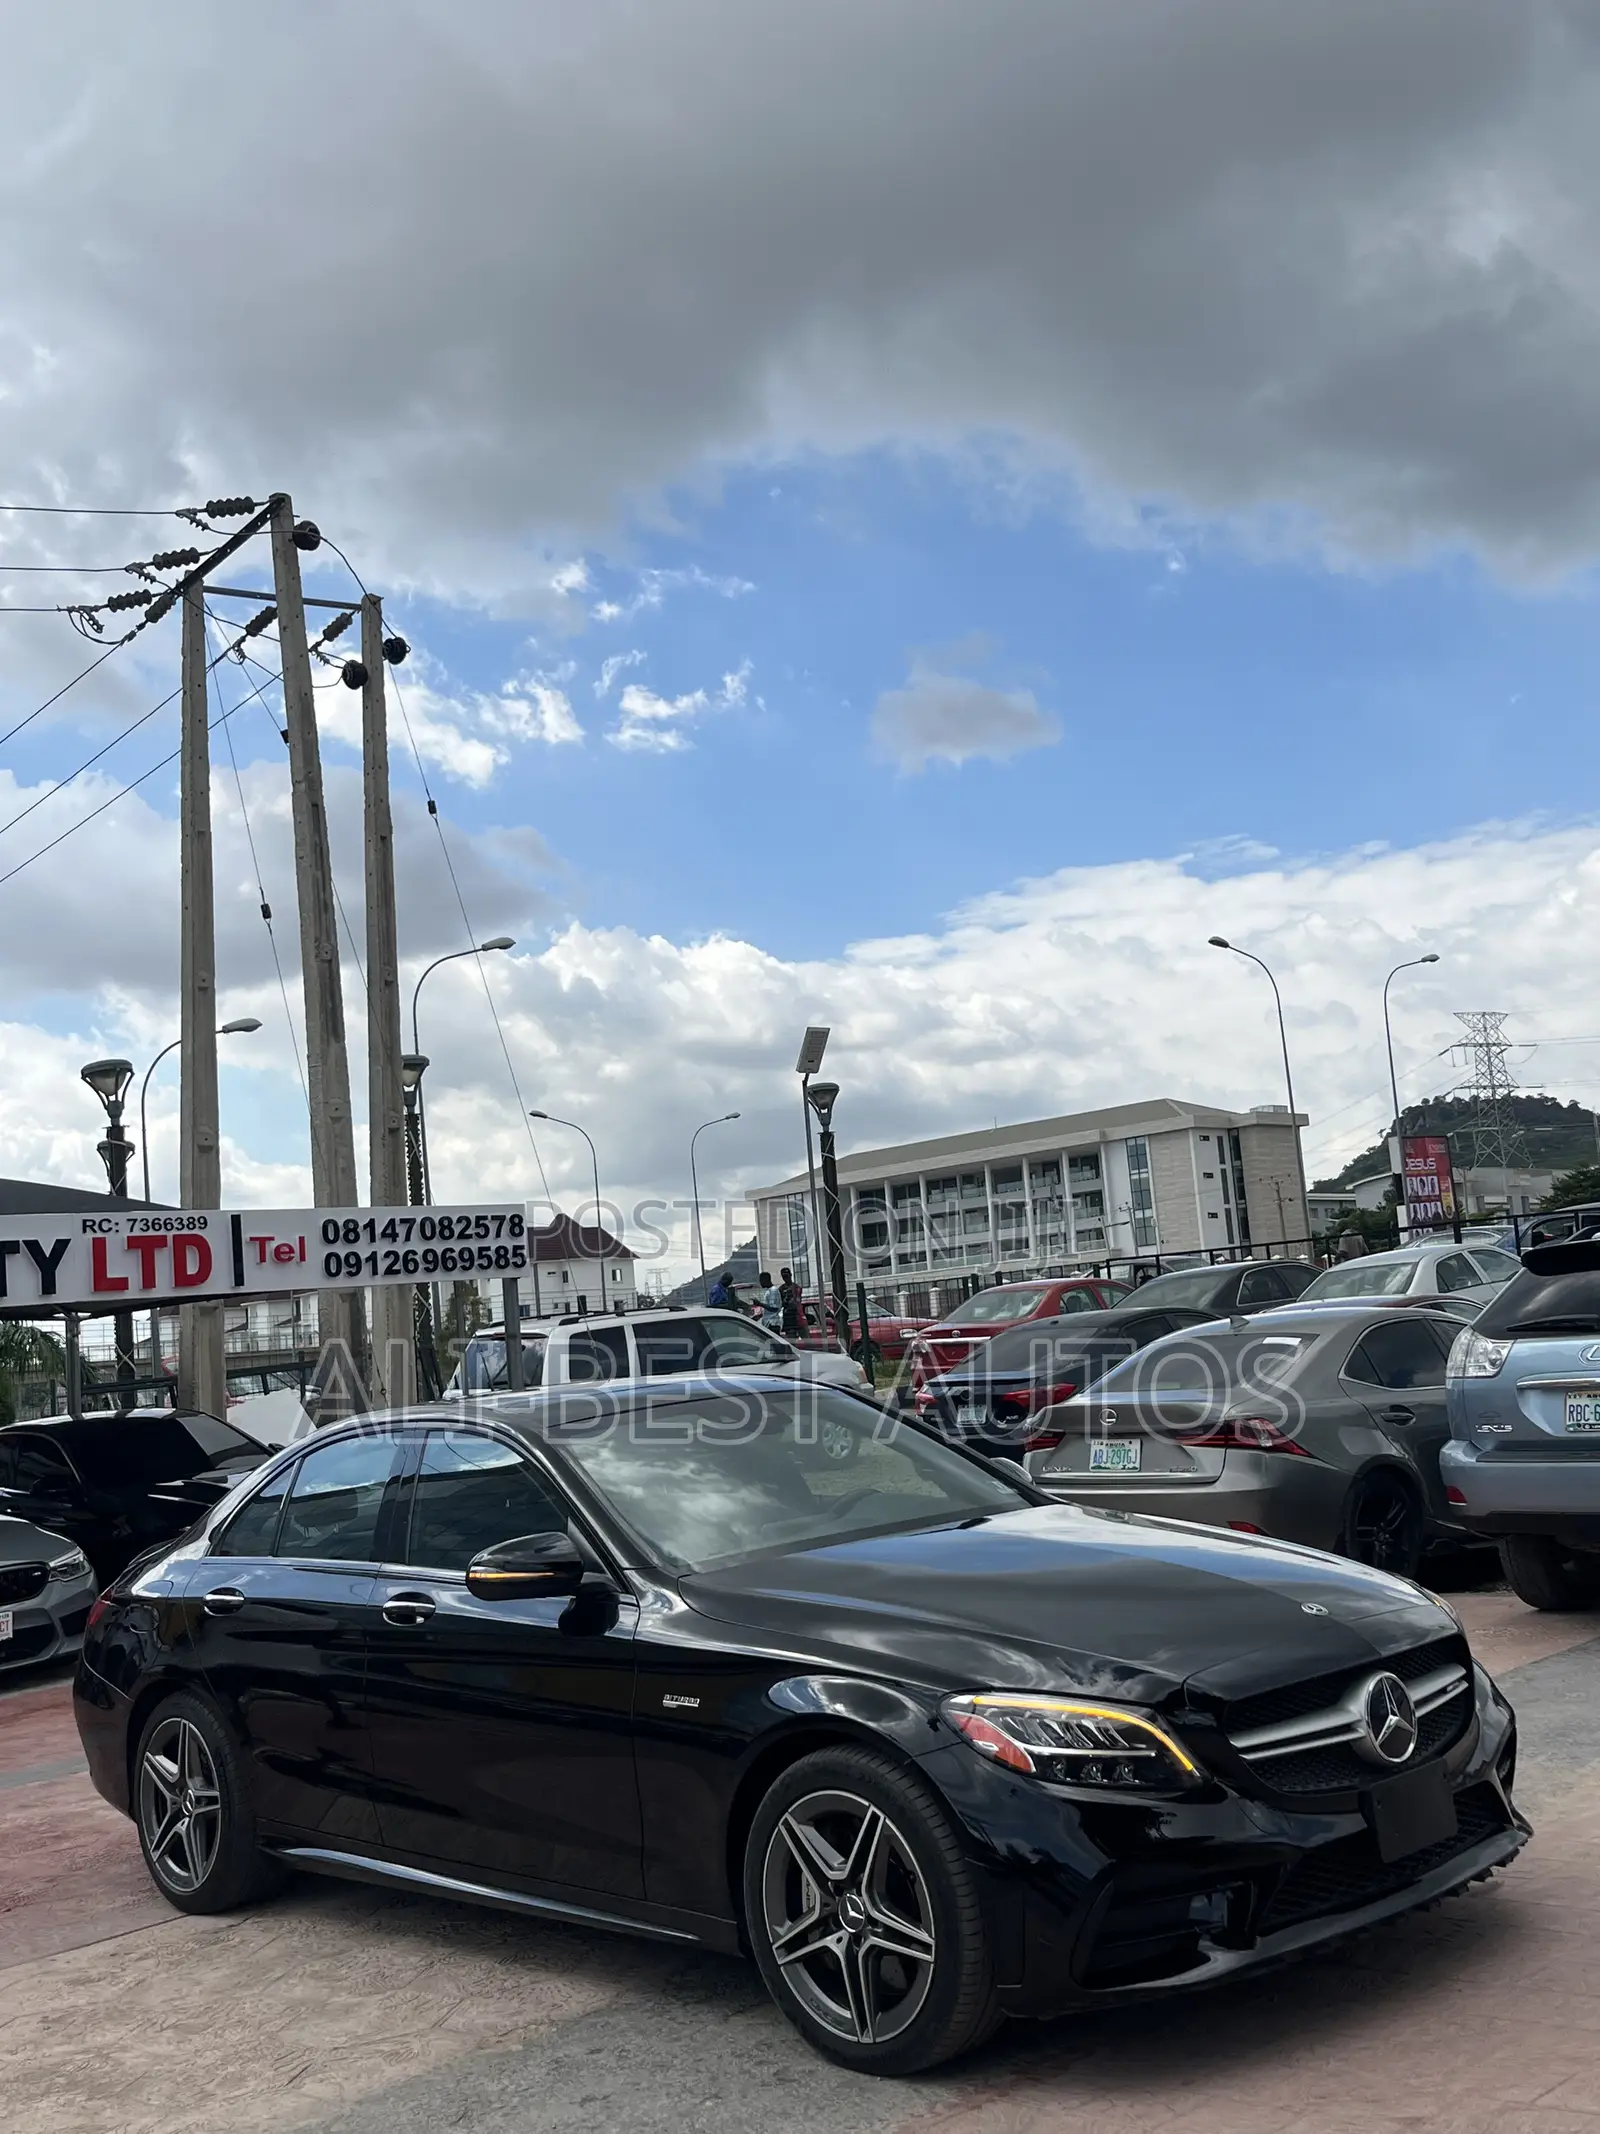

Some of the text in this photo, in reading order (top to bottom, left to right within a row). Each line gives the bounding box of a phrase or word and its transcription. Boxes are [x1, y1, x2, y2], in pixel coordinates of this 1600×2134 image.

[1405, 1157, 1437, 1171] JESUS
[81, 1215, 208, 1234] RC: 7366389
[321, 1212, 526, 1246] 08147082578
[91, 1233, 213, 1293] LTD
[249, 1235, 306, 1264] Tel
[323, 1243, 528, 1278] 09126969585
[1092, 1448, 1138, 1465] ABJ-297GJ
